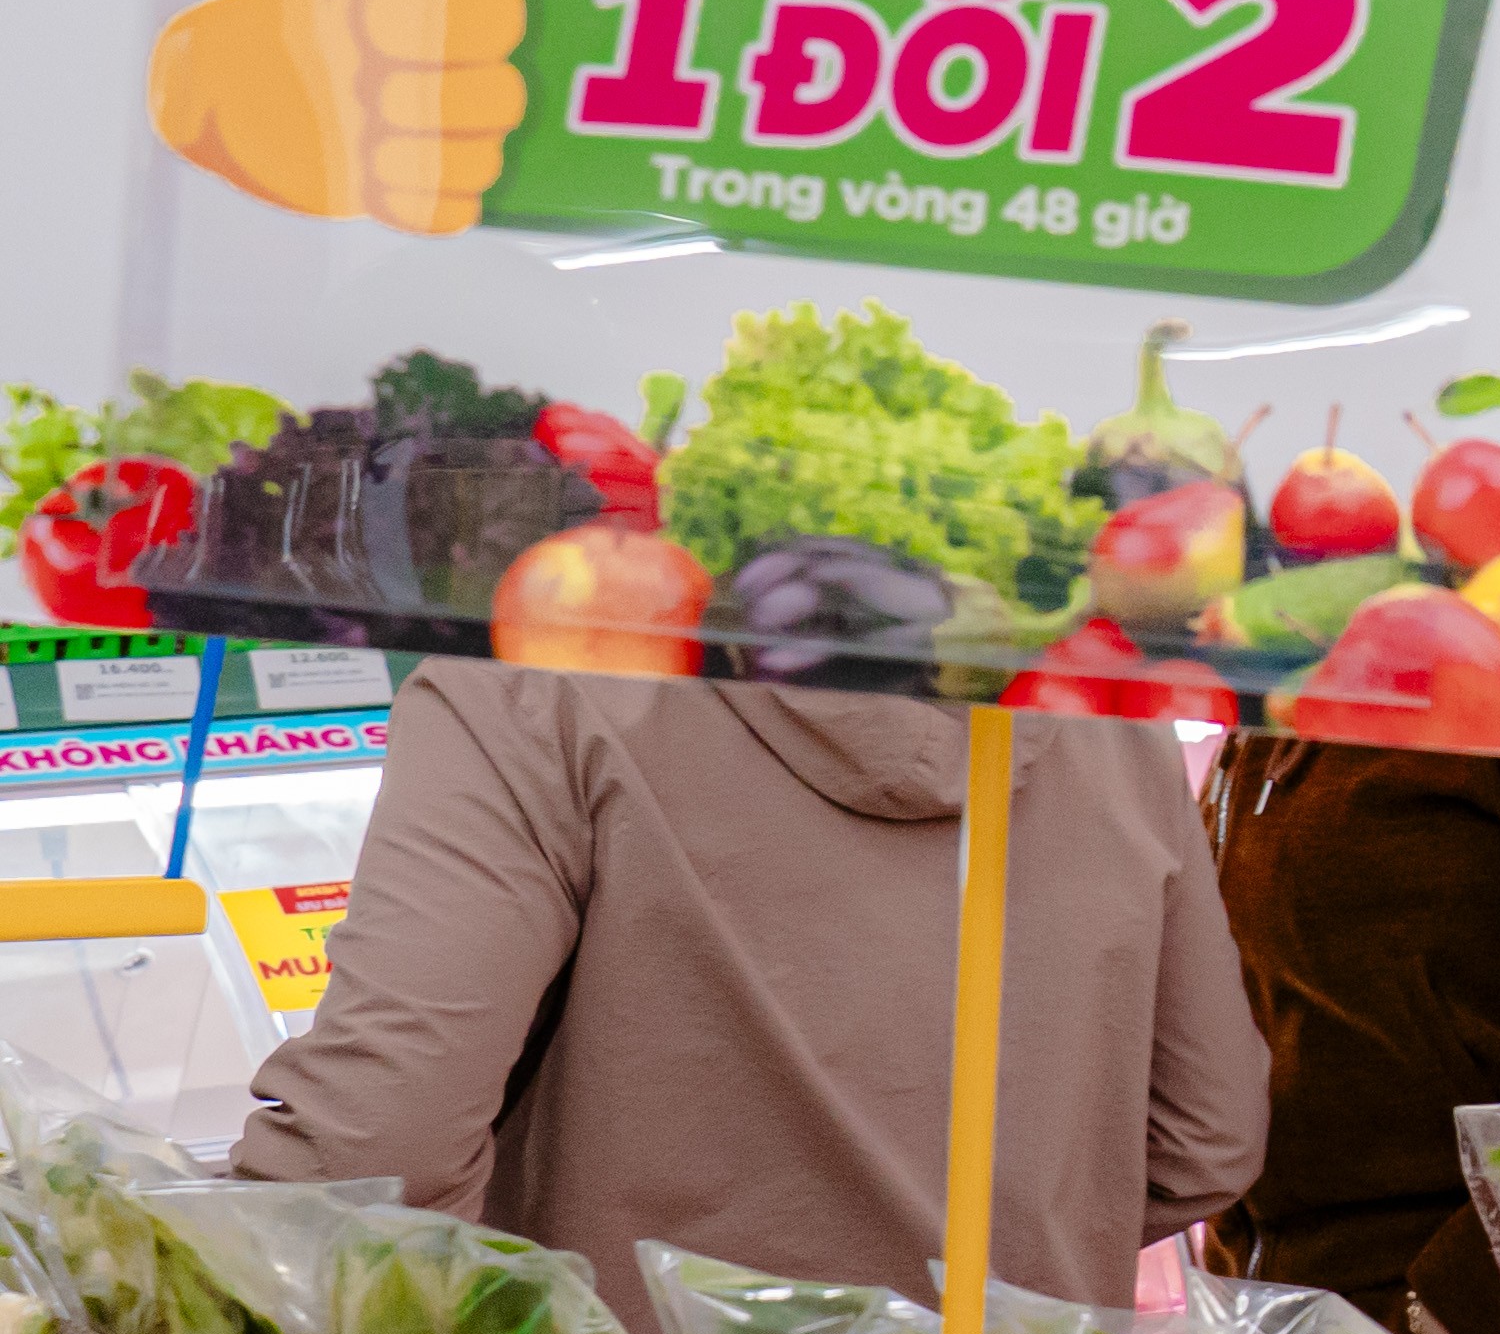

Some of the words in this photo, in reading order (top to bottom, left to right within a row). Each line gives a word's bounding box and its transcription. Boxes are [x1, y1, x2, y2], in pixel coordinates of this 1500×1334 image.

[651, 154, 823, 221] Trong
[841, 170, 988, 235] vòng
[1001, 187, 1079, 233] 48
[1093, 194, 1191, 250] giờ
